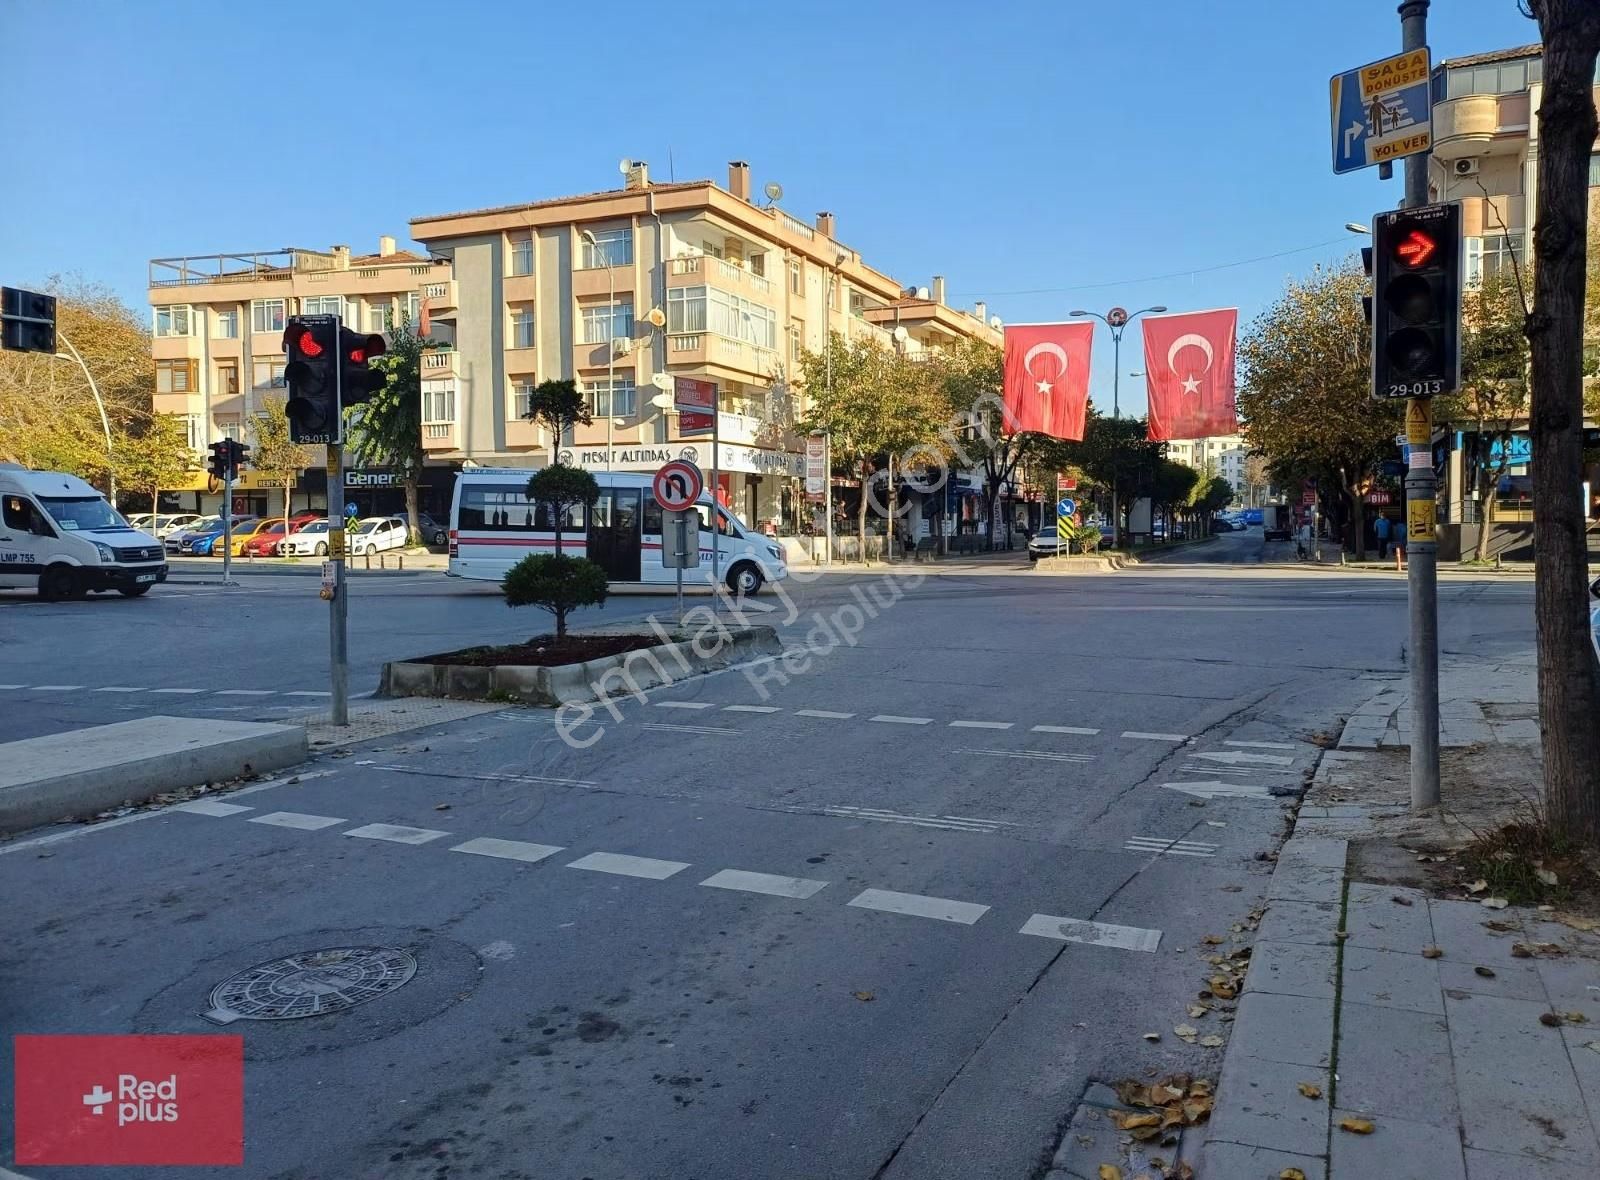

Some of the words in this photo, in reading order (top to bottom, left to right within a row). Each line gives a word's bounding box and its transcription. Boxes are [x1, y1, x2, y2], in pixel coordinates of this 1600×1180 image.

[1375, 144, 1398, 157] YOL
[1403, 135, 1428, 149] VER
[1389, 382, 1441, 397] 29-013
[300, 434, 330, 443] 29-013
[1371, 493, 1389, 503] BİM
[1, 554, 18, 562] LMP
[20, 554, 35, 563] 755
